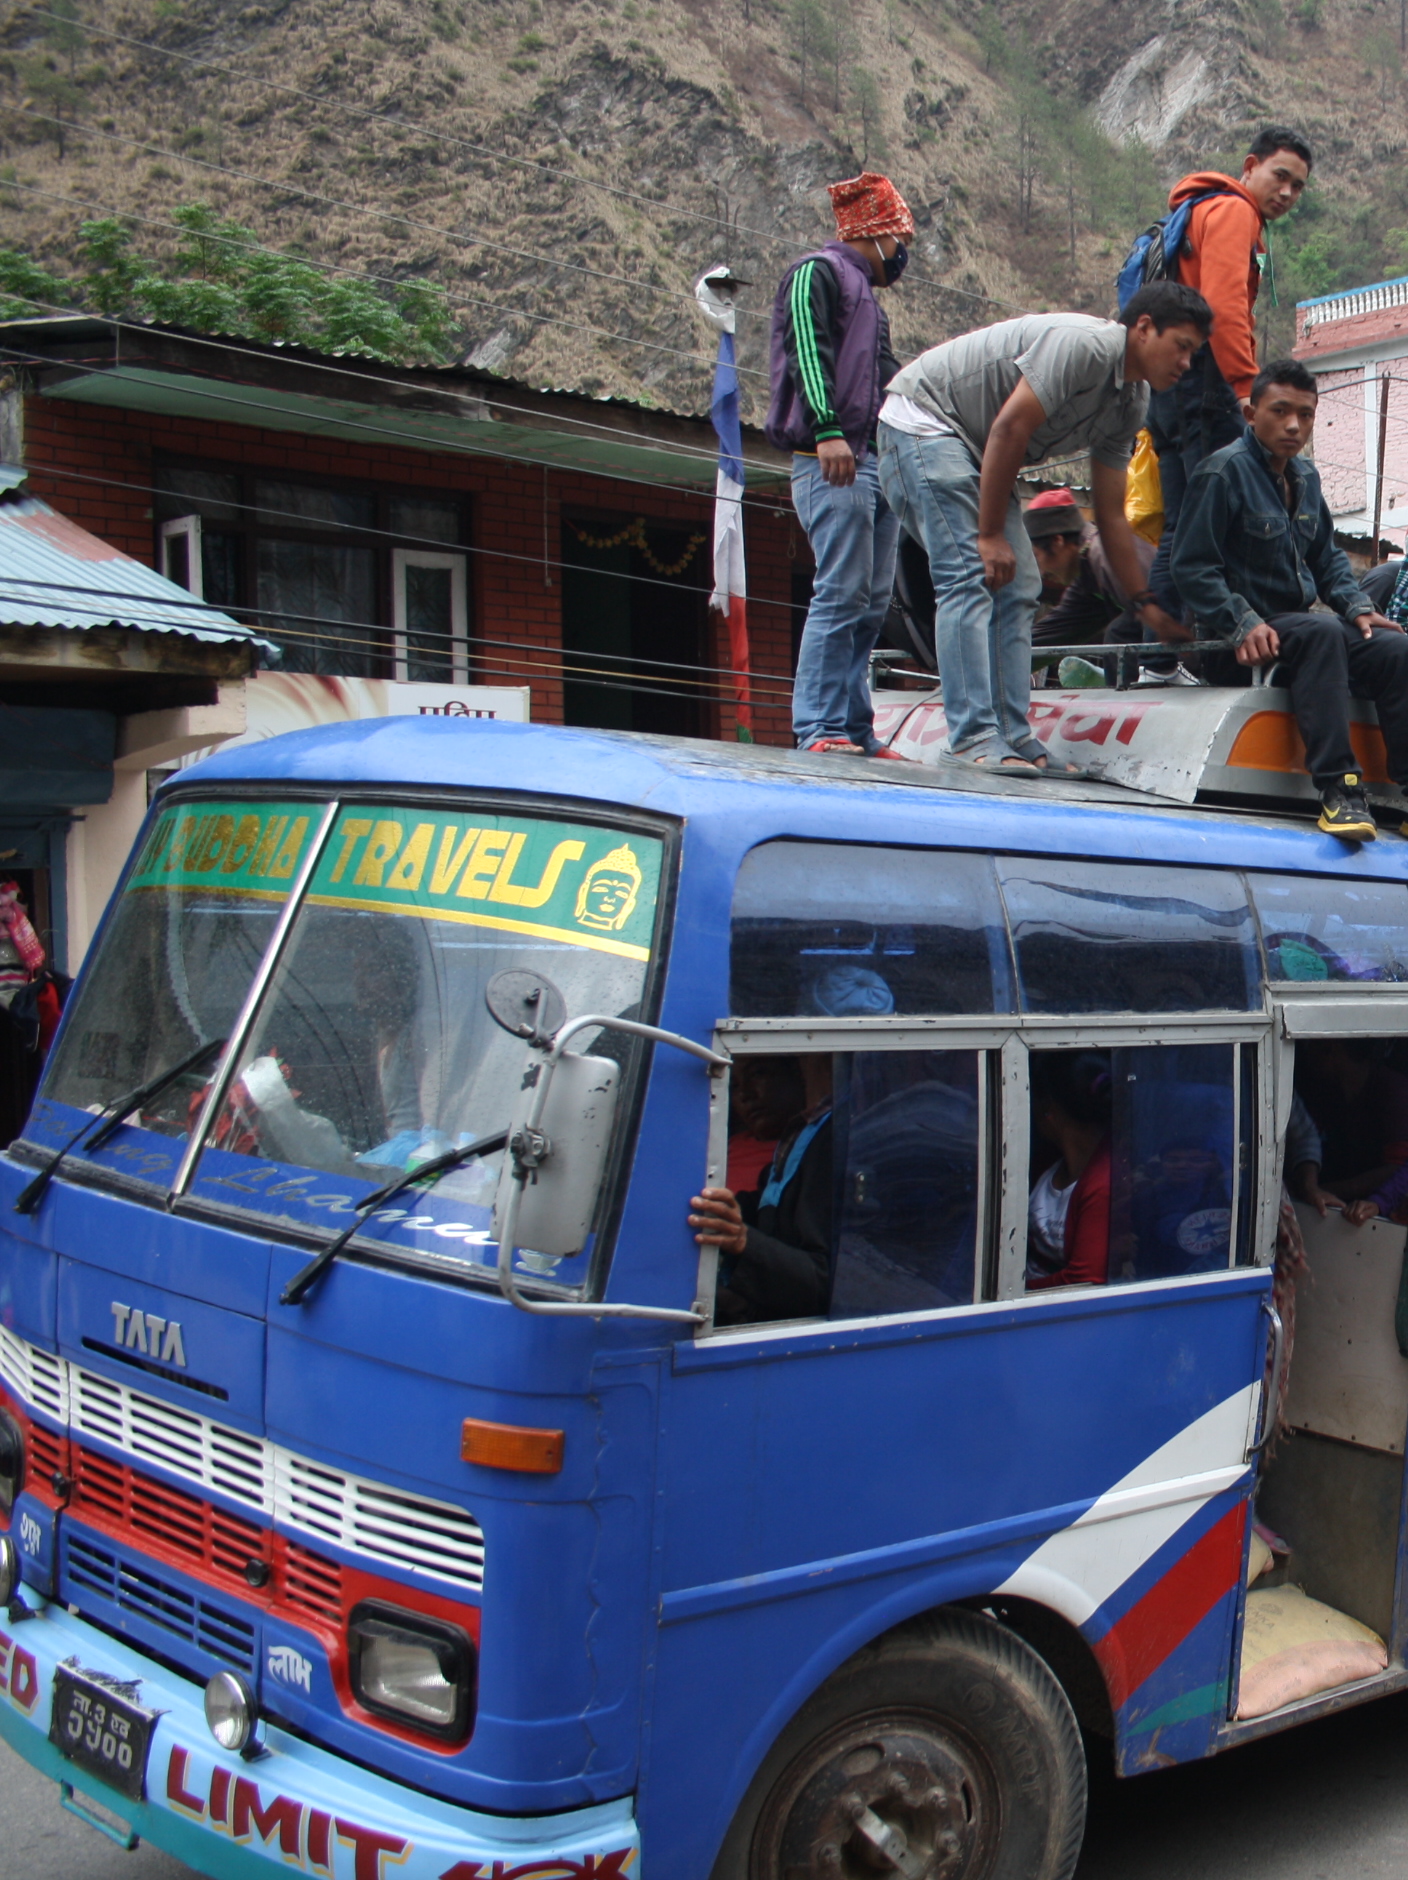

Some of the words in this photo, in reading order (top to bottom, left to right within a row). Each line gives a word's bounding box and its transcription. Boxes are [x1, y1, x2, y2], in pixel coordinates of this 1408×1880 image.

[161, 814, 310, 880] BUDDHA
[329, 816, 588, 908] TRAVELS
[111, 1301, 187, 1367] TATA
[267, 1645, 313, 1694] लाभ
[166, 1743, 410, 1880] LIMIT
